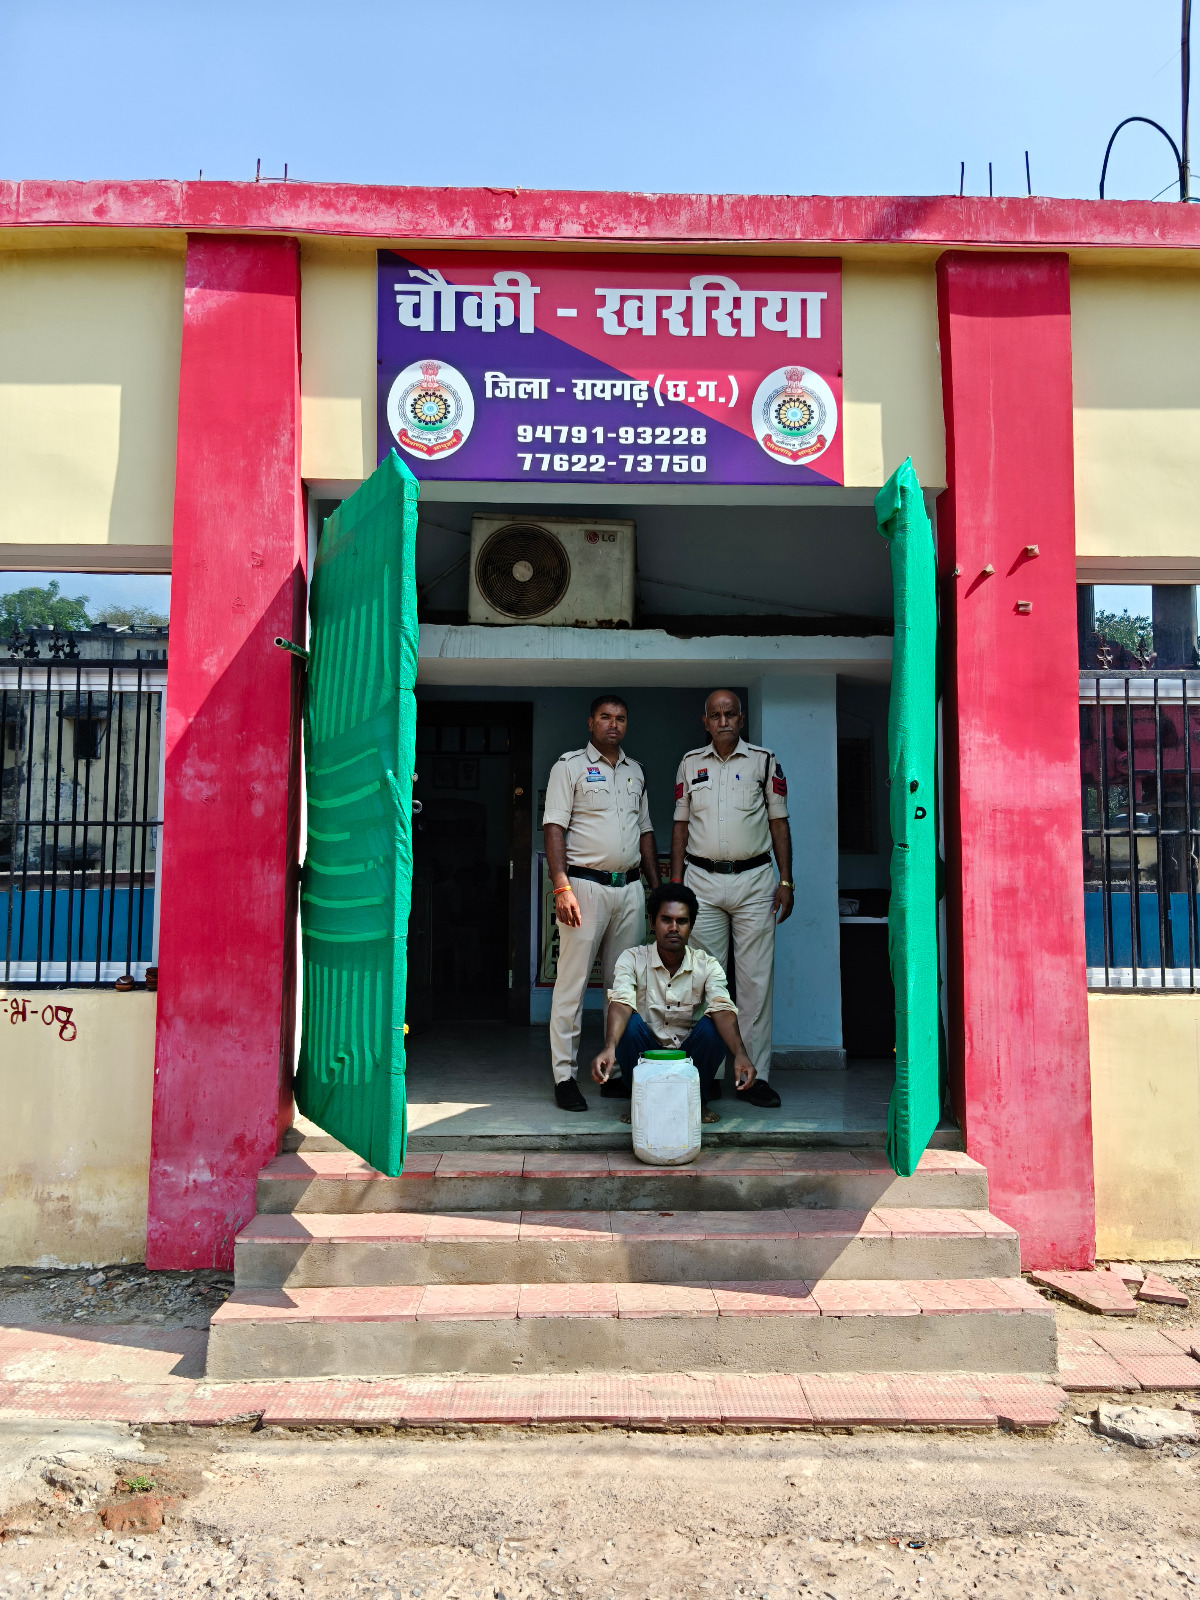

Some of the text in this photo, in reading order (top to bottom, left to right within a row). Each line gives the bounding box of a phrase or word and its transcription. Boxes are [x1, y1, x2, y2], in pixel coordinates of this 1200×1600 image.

[394, 269, 541, 334] चौकी
[594, 275, 828, 339] खरसिया
[484, 371, 551, 400] जिला
[517, 424, 707, 445] 94791-93228
[516, 453, 707, 473] 77622-73750
[602, 534, 616, 543] LG
